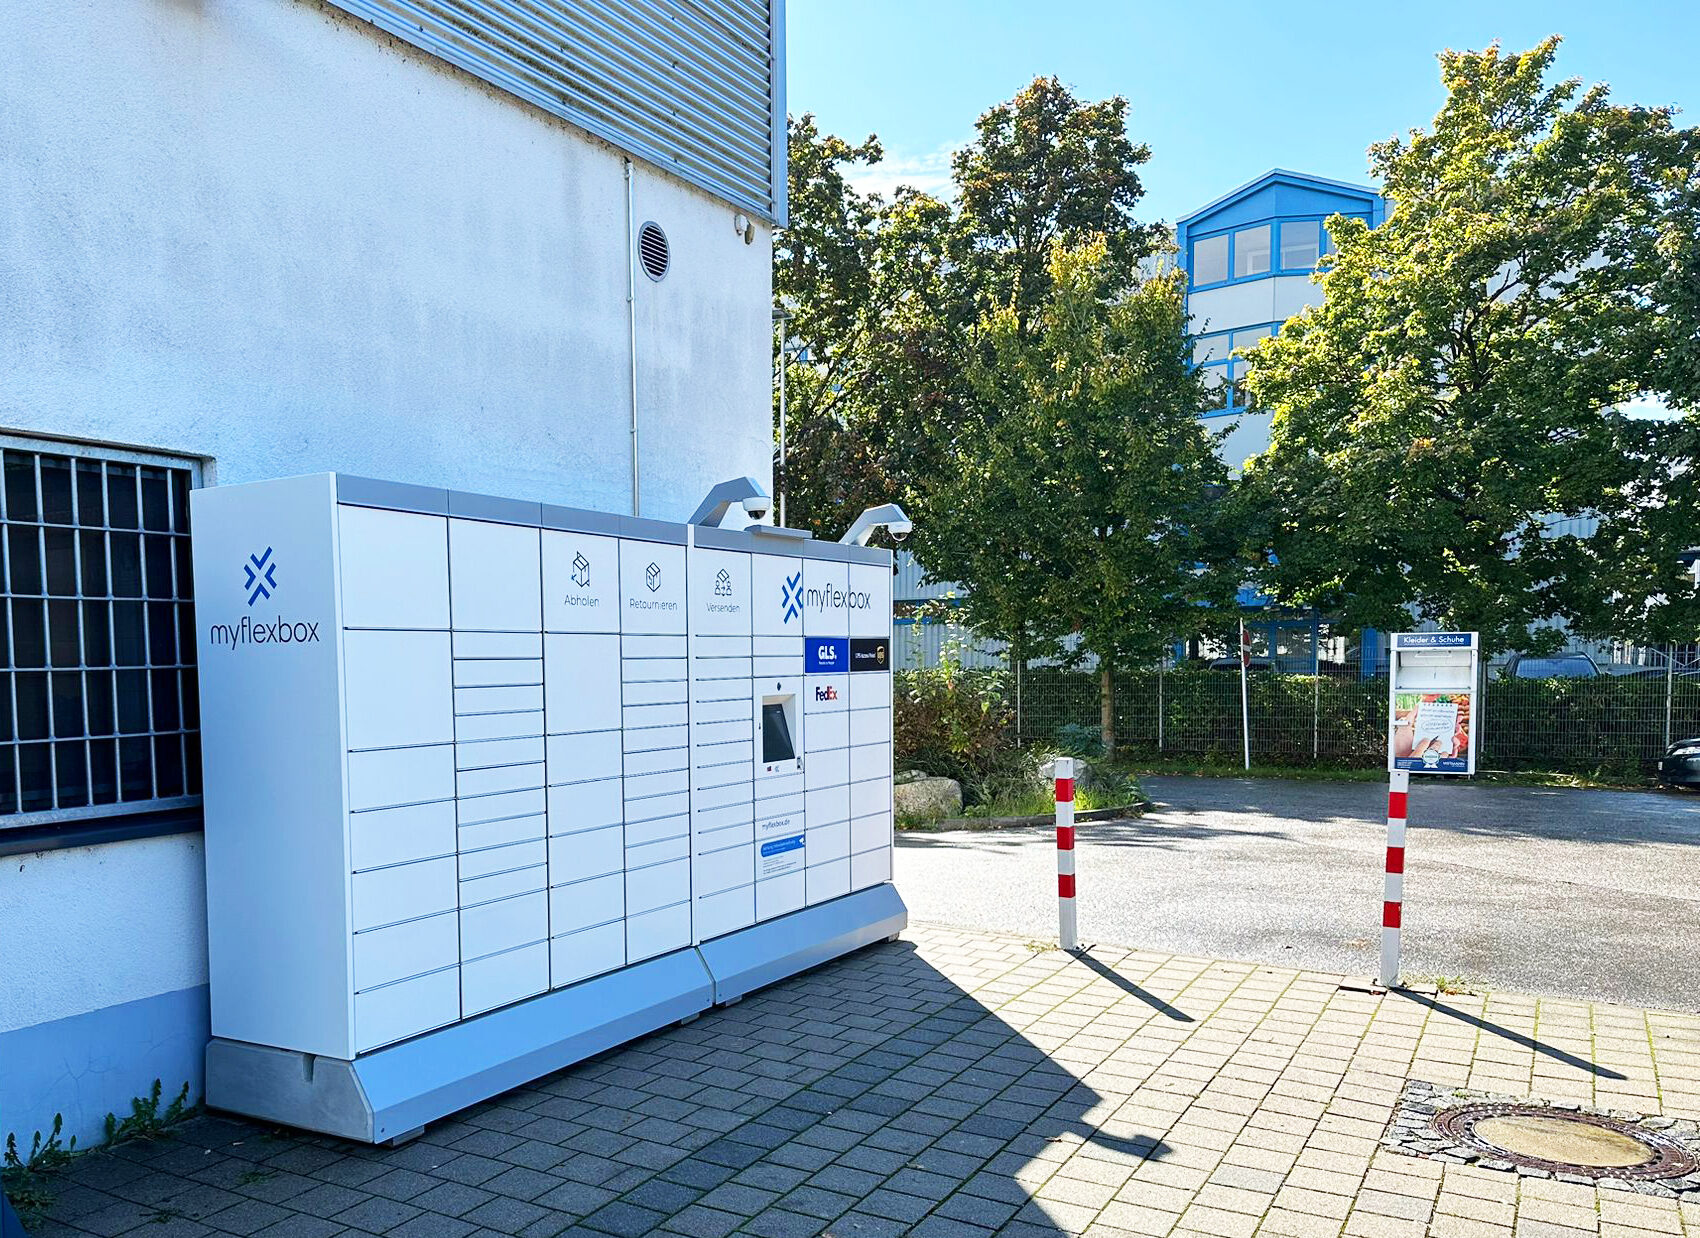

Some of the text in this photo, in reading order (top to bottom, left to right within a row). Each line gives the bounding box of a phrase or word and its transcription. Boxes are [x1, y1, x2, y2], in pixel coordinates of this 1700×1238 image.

[564, 594, 600, 607] Abholen
[629, 598, 678, 611] Retournieren
[806, 583, 872, 613] myflexbox
[706, 602, 741, 613] Versenden
[210, 615, 320, 651] myflexbox
[1438, 635, 1465, 643] Schuhe
[815, 685, 838, 701] FedEx
[762, 819, 790, 830] myflexbox.de
